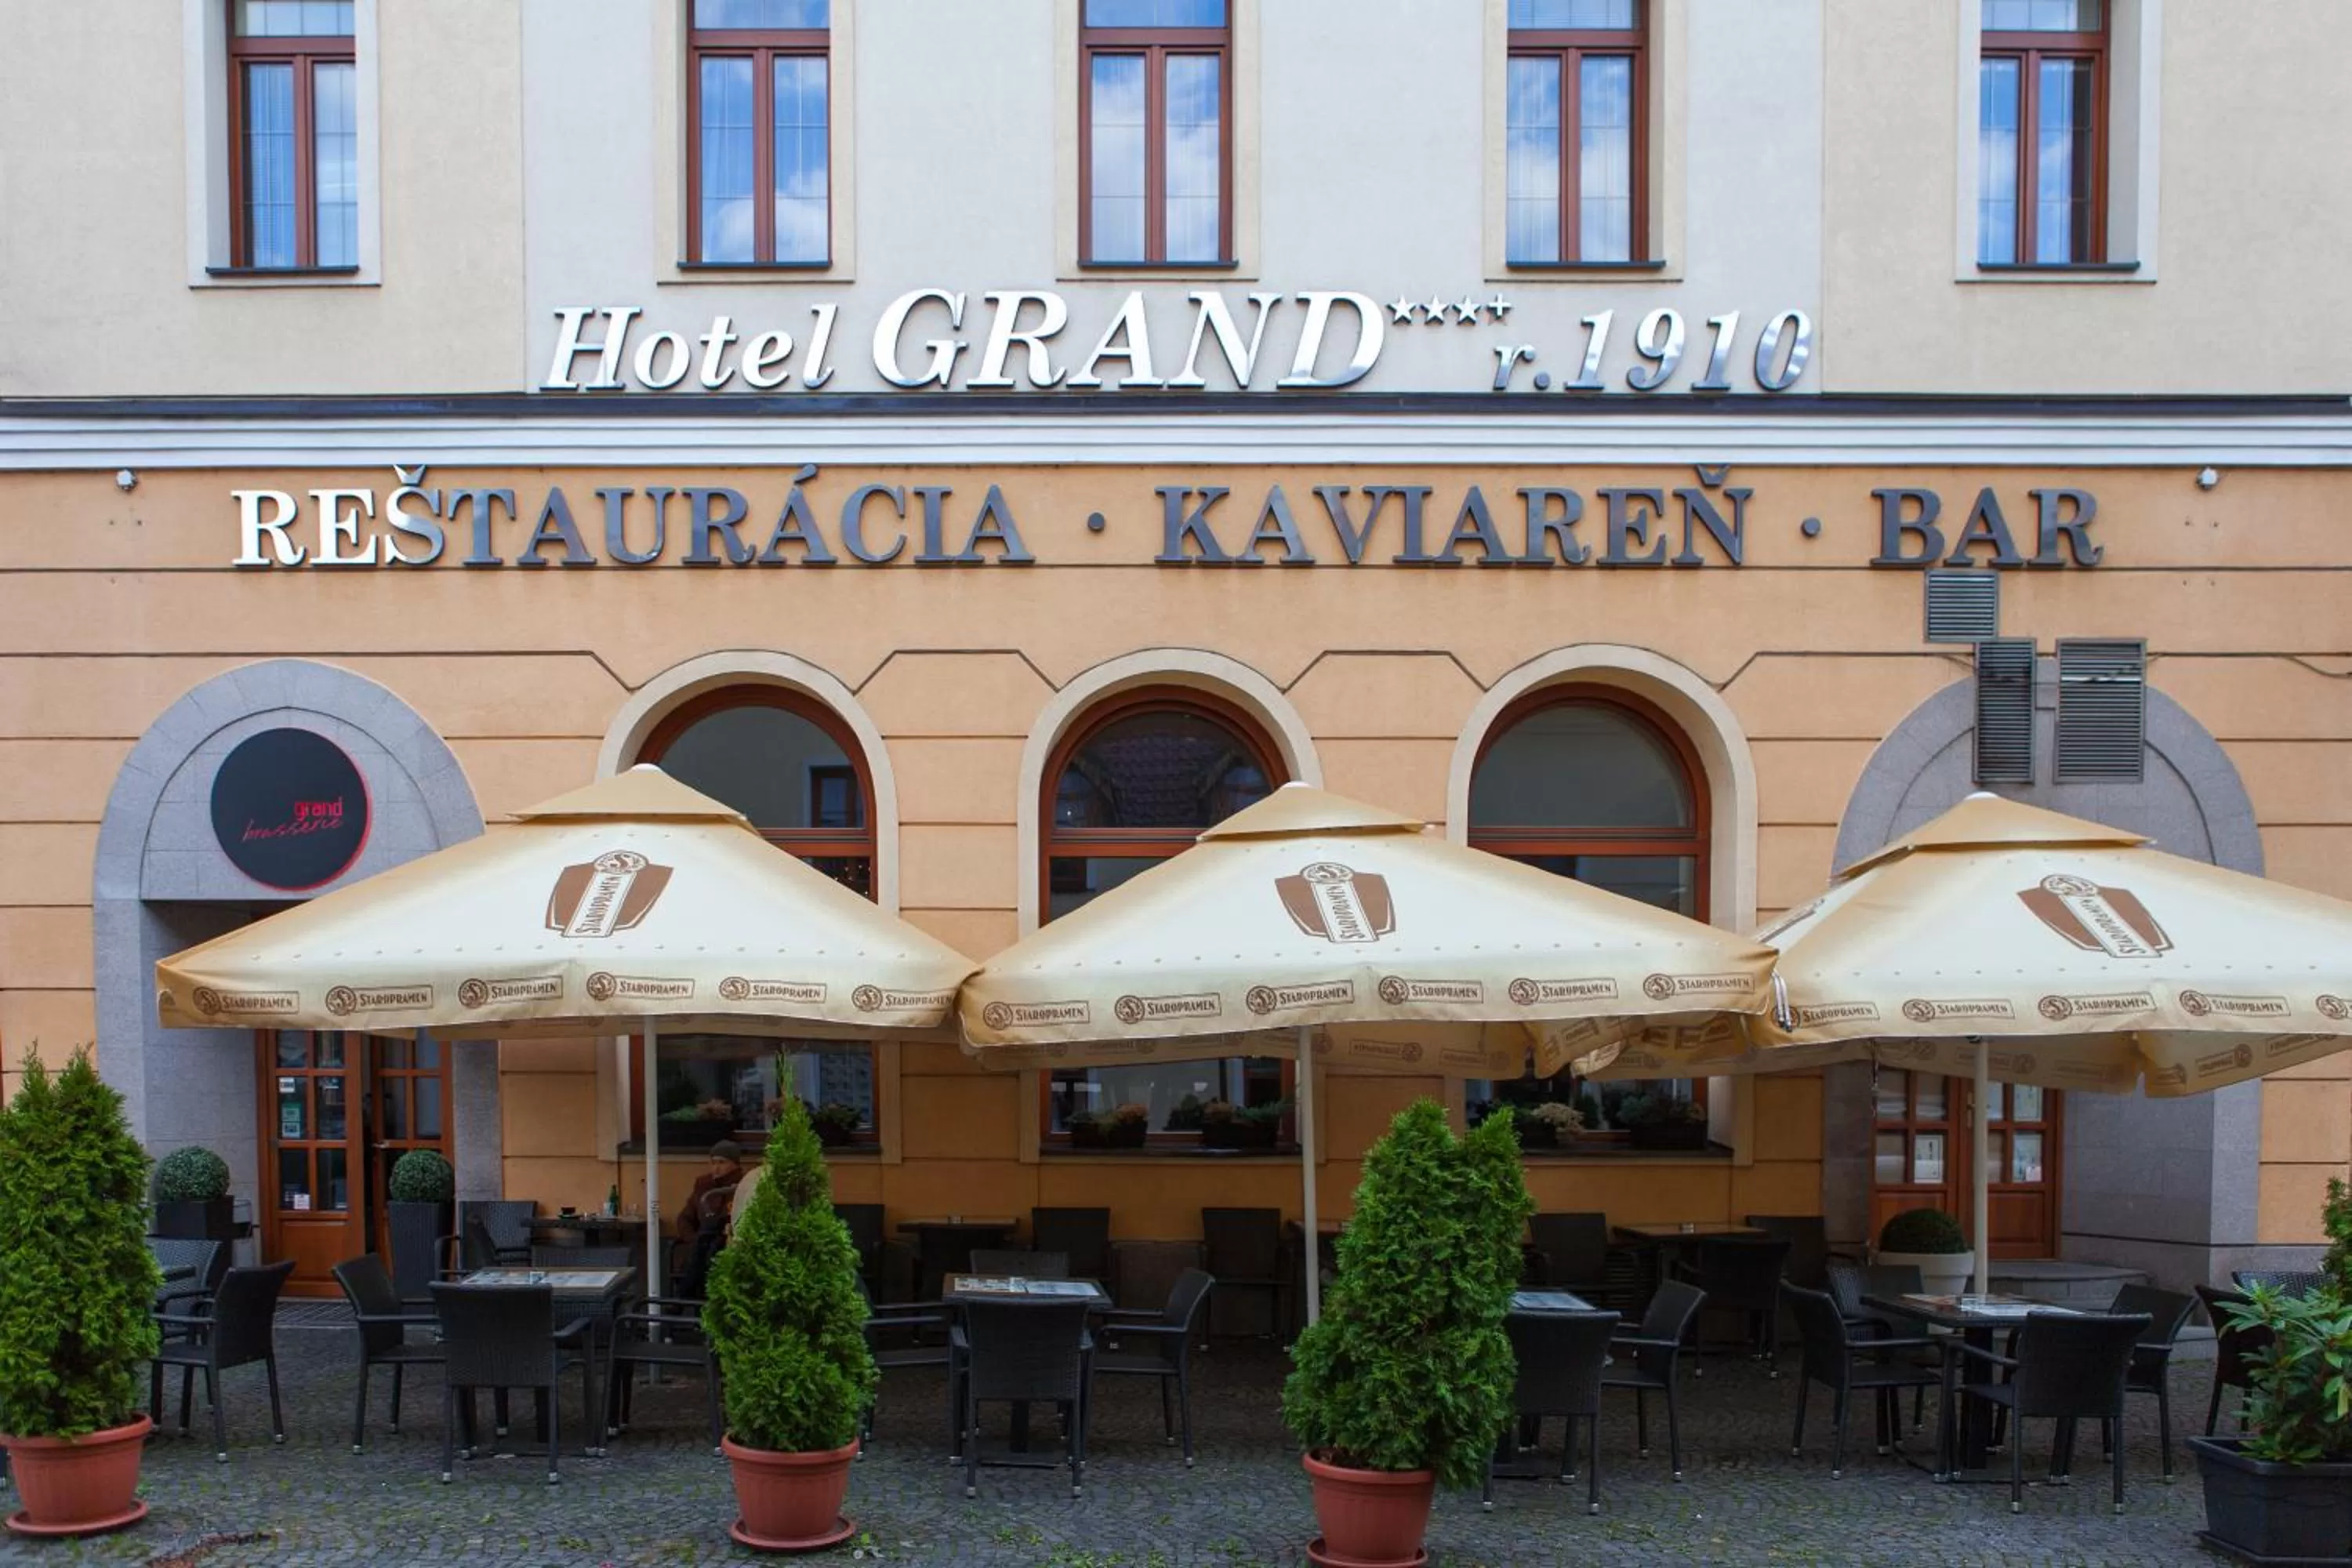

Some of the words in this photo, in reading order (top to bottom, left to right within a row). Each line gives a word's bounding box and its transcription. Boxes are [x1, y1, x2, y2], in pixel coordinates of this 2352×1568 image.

[539, 301, 838, 395] Hotel
[873, 288, 1385, 394] GRAND
[1492, 339, 1551, 392] r.
[1564, 306, 1813, 394] 1910
[230, 463, 1036, 568] REŠTAURÁCIA
[1153, 463, 1753, 566] KAVIAREŇ
[1869, 487, 2104, 568] BAR
[294, 796, 343, 822] grand
